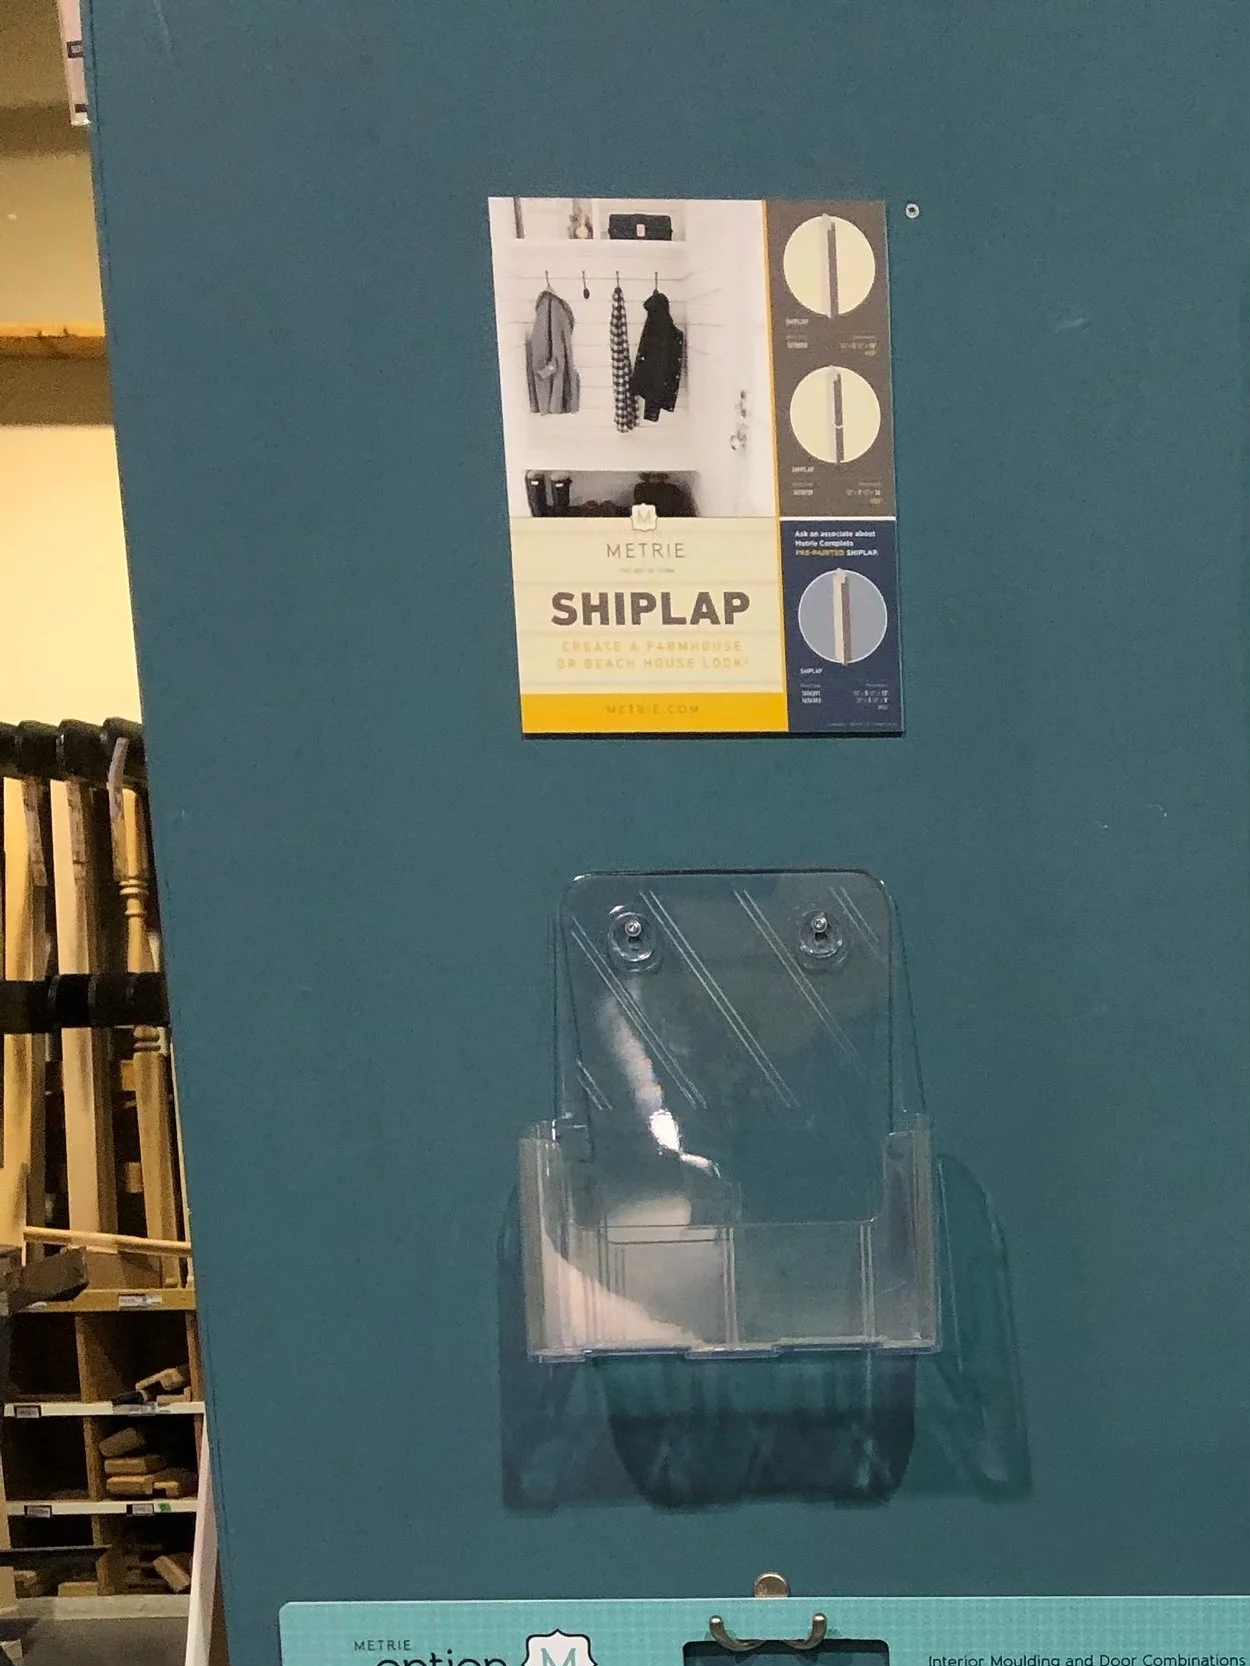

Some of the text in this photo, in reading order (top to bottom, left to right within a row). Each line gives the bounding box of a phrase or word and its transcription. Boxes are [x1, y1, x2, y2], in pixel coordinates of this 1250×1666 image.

[795, 530, 808, 538] Ask
[820, 530, 853, 538] associate
[855, 530, 876, 538] about
[606, 542, 685, 558] METRIE
[819, 540, 854, 548] Complete
[796, 549, 844, 557] PRE-PAINTED
[551, 591, 750, 626] SHIPLAP
[562, 640, 742, 652] CREATE A FARMHOUSE
[557, 658, 576, 669] OR
[584, 658, 636, 670] BEACH
[643, 657, 695, 669] HOUSE
[354, 1639, 412, 1651] METRIE
